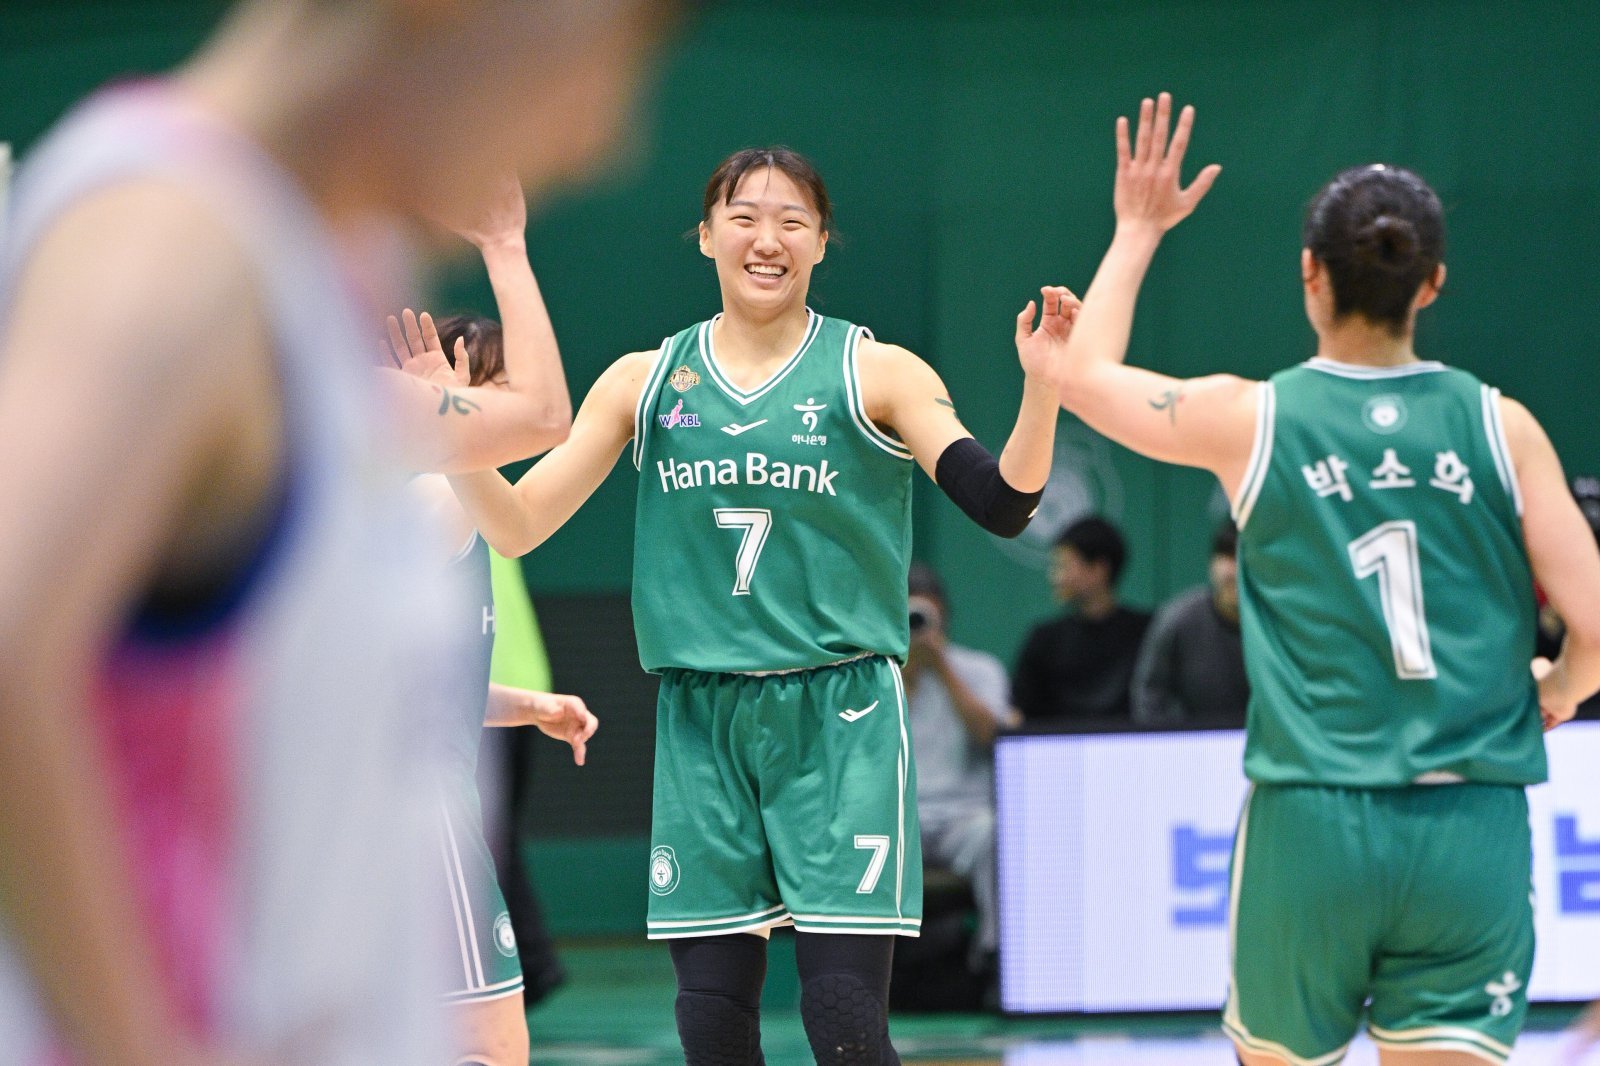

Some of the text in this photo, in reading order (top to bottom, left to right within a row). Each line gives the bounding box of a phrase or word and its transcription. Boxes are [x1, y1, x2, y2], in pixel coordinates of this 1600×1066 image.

[791, 434, 827, 446] 하나은행
[657, 452, 839, 496] Hana Bank
[1302, 454, 1353, 502] 박
[1369, 448, 1416, 489] 소
[713, 508, 772, 596] 7
[1347, 520, 1438, 680] 1
[854, 835, 889, 894] 7
